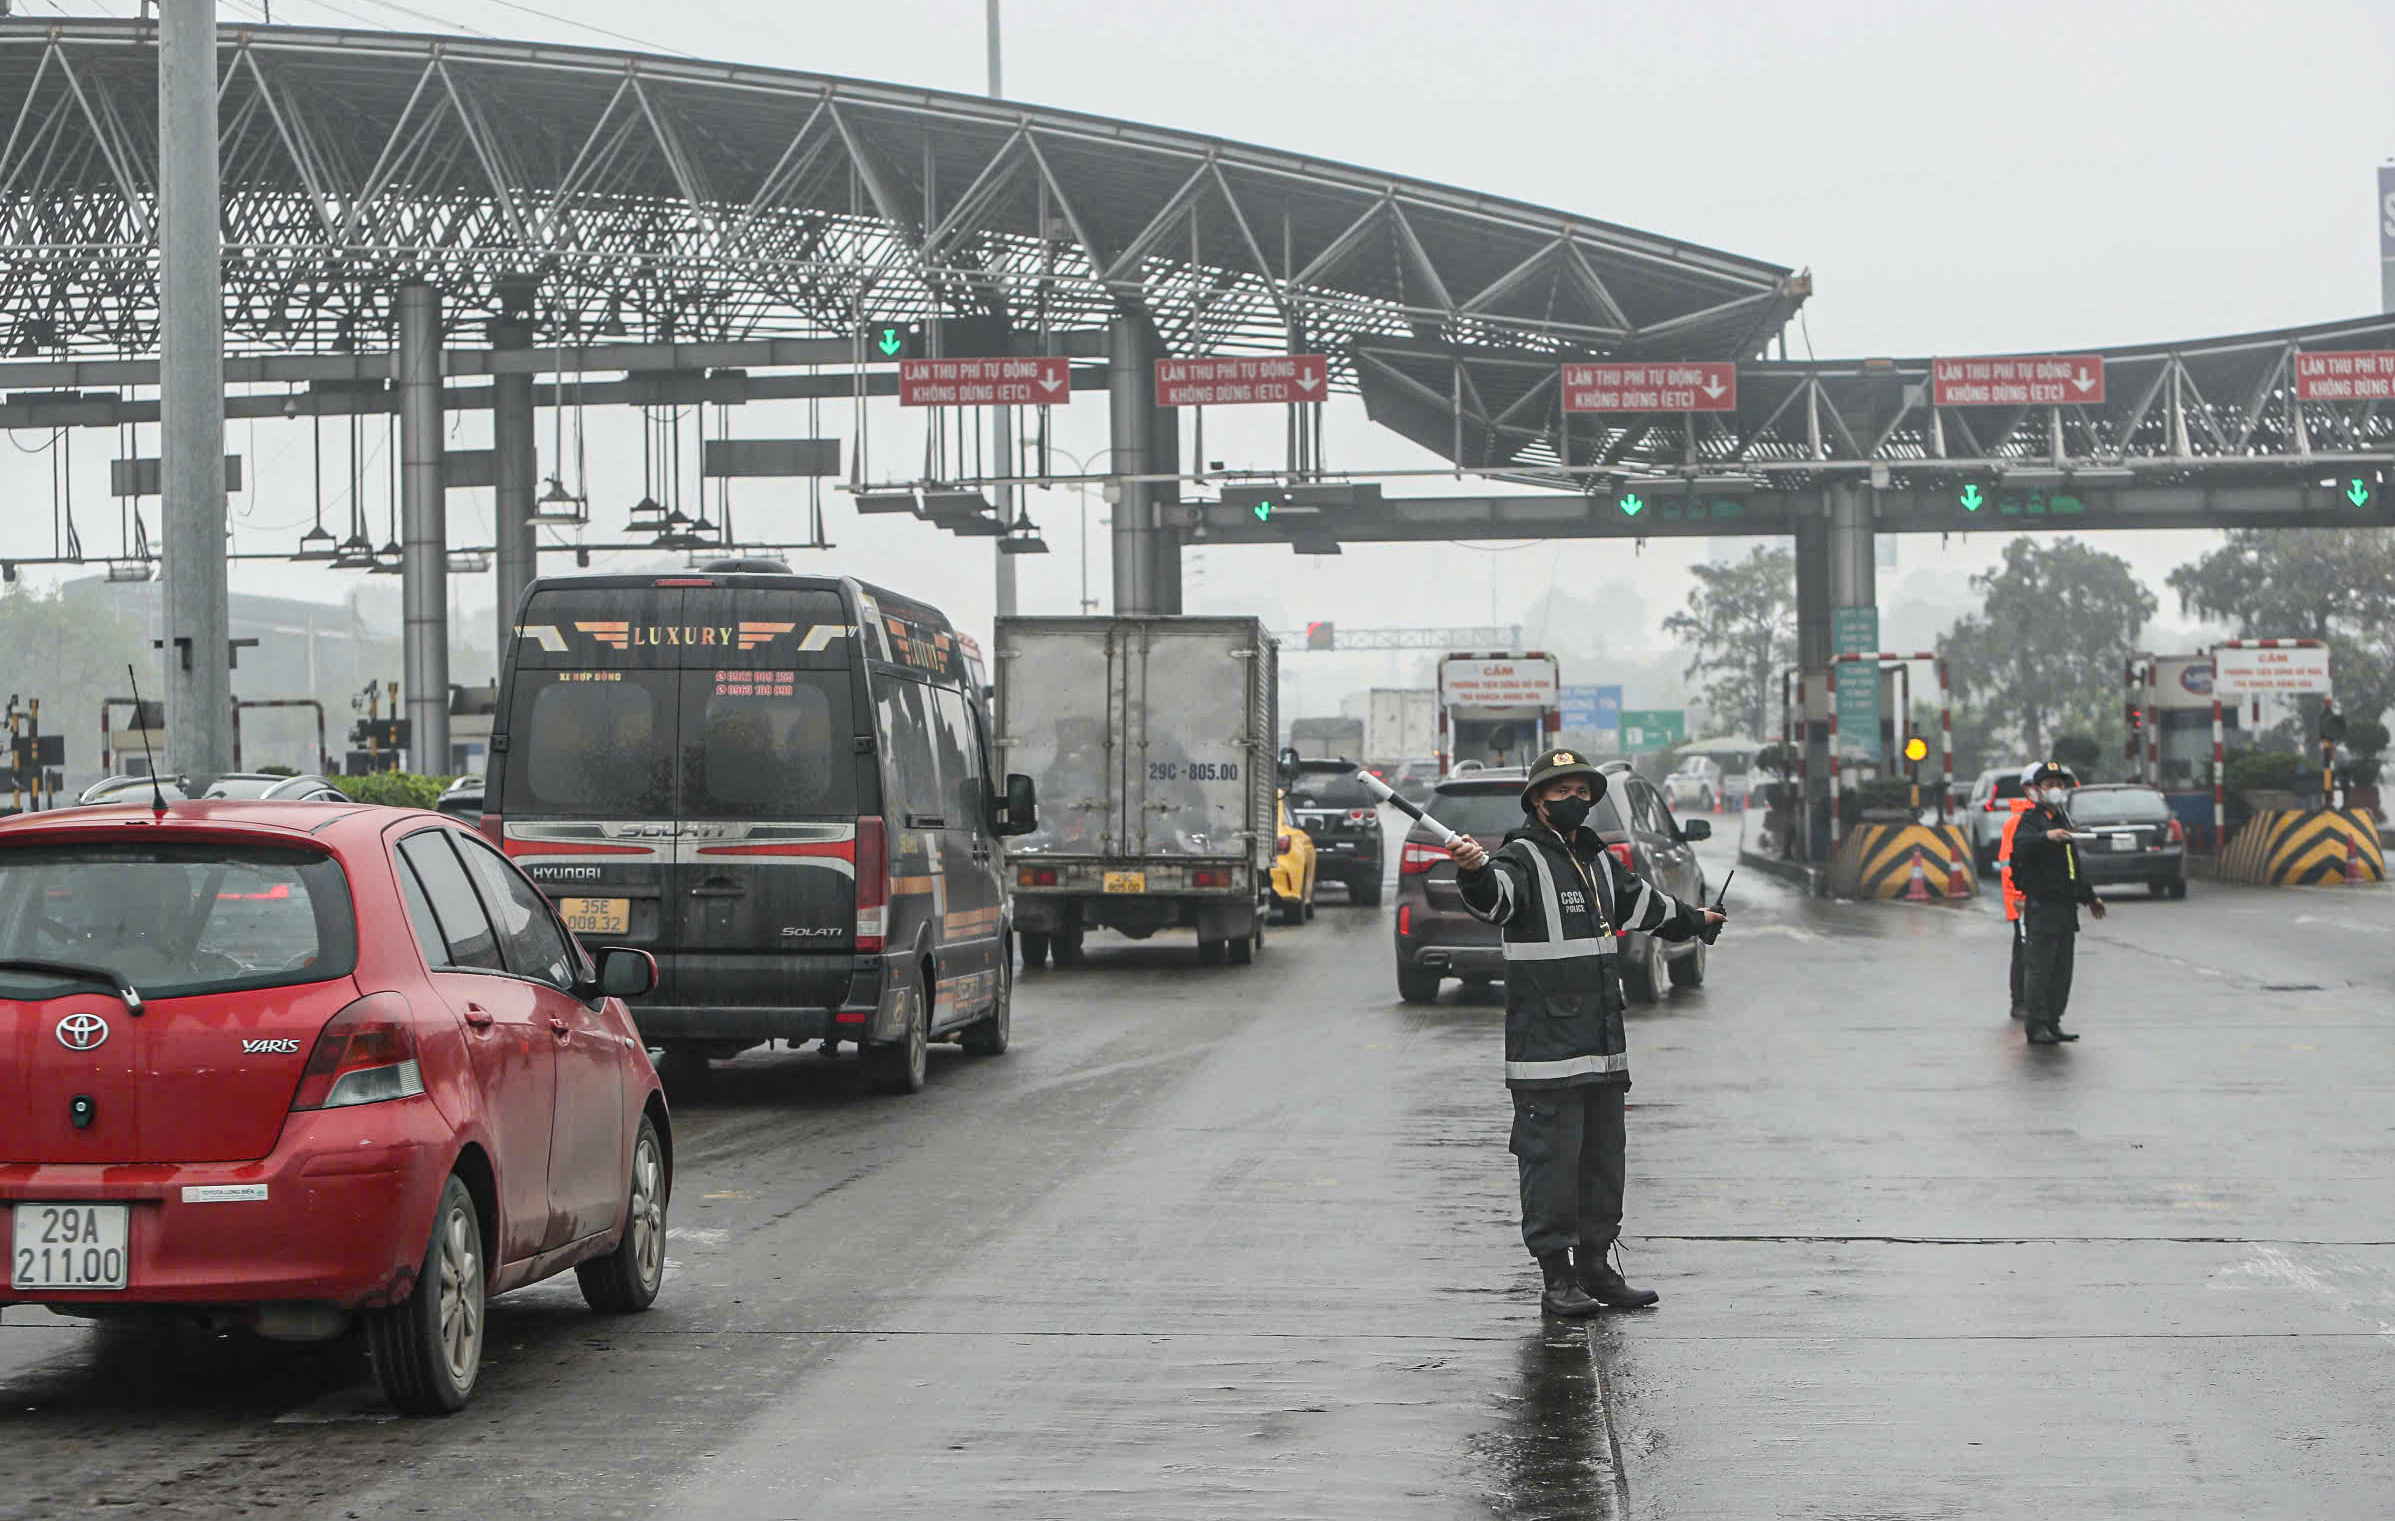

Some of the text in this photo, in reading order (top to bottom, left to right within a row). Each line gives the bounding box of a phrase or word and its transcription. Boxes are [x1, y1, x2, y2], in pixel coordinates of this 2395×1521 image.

[932, 362, 957, 379] THU
[1189, 364, 1214, 381] THU
[634, 627, 733, 646] LUXURY
[1150, 762, 1177, 780] 29C
[1189, 762, 1239, 780] 805.00
[617, 824, 725, 837] SOLATI
[533, 867, 601, 879] HYUNDAI
[580, 900, 609, 914] 35E
[1566, 904, 1586, 913] POLICE
[568, 916, 620, 930] 008.32
[780, 927, 842, 936] SOLATI
[41, 1208, 98, 1244] 29A
[17, 1247, 121, 1284] 211.00
